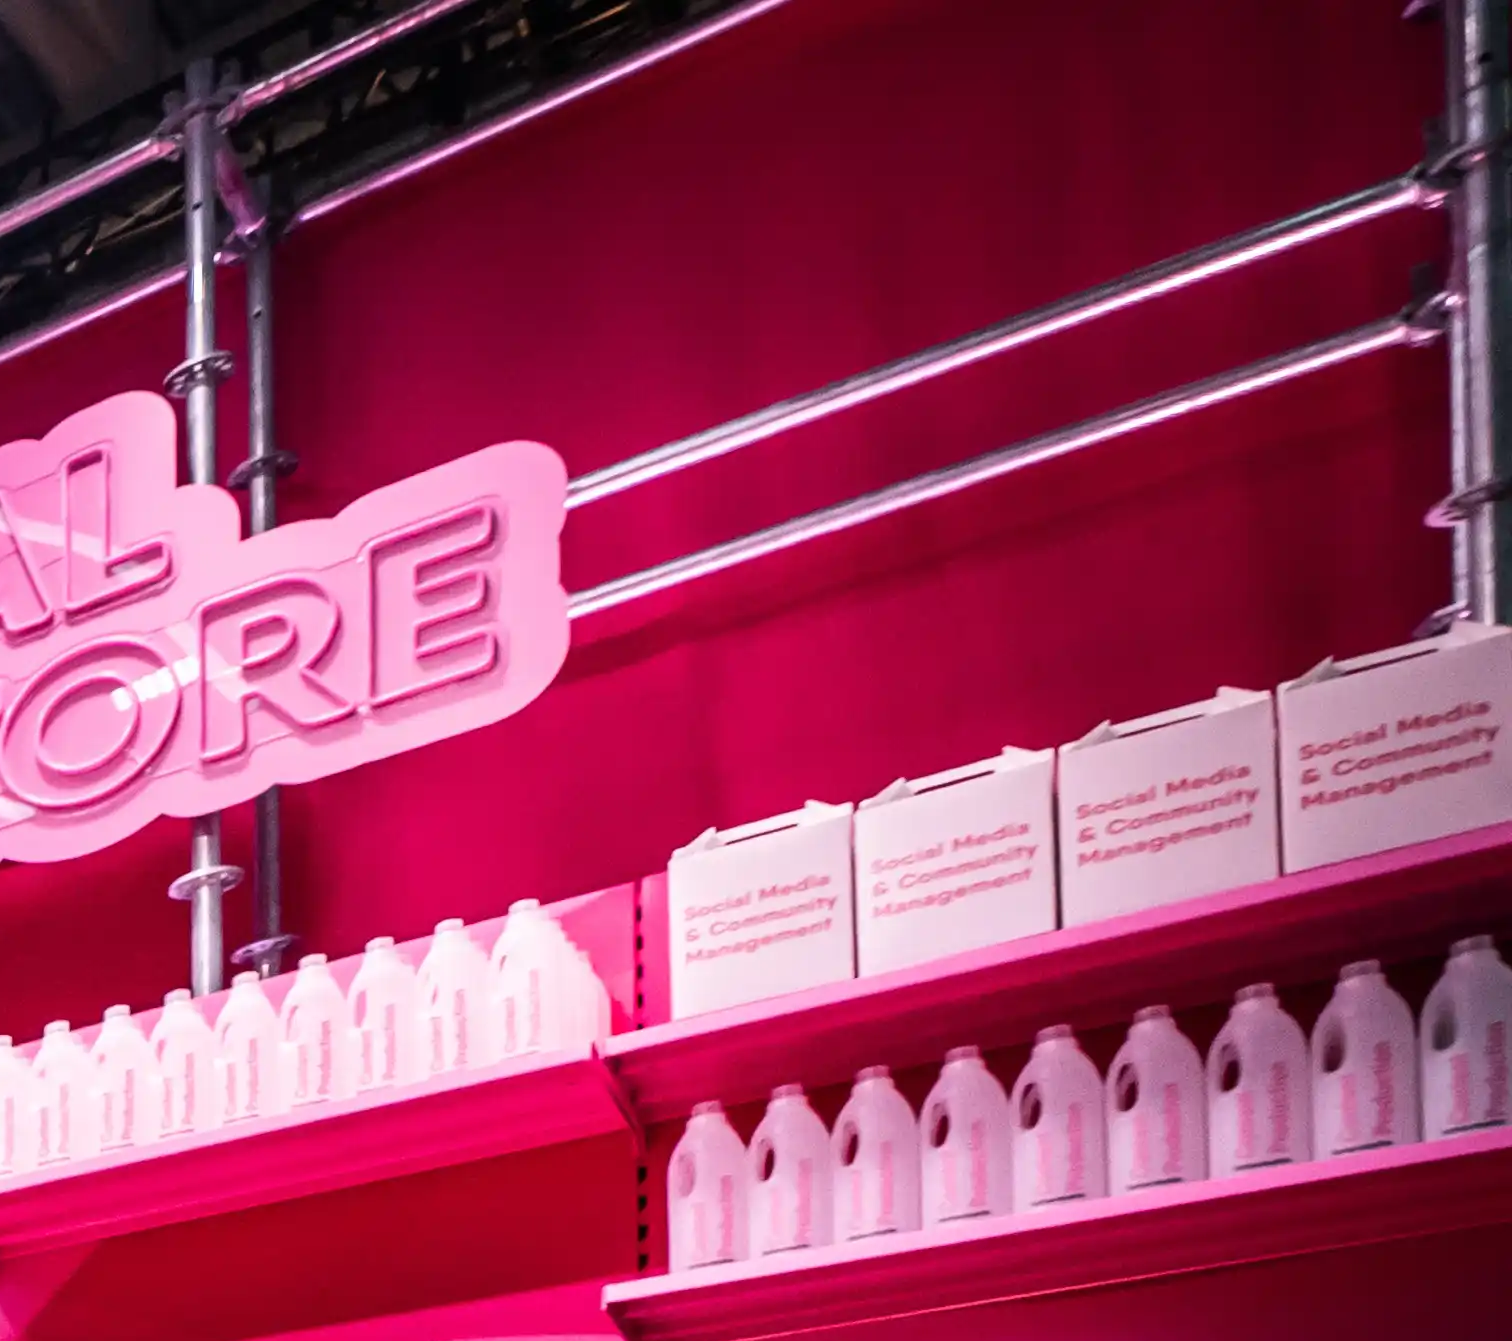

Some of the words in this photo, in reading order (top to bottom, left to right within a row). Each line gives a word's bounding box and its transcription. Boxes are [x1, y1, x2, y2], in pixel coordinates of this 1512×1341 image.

[1299, 723, 1388, 761] Social
[1397, 700, 1492, 734] Media
[1301, 768, 1321, 785] &
[1332, 723, 1502, 777] Community
[1076, 787, 1156, 820] Social
[1165, 764, 1251, 798] Media
[1301, 751, 1493, 810] Management
[1077, 827, 1097, 843] &
[1105, 787, 1260, 835] Community
[1077, 812, 1253, 867] Management
[872, 868, 1032, 918] Management
